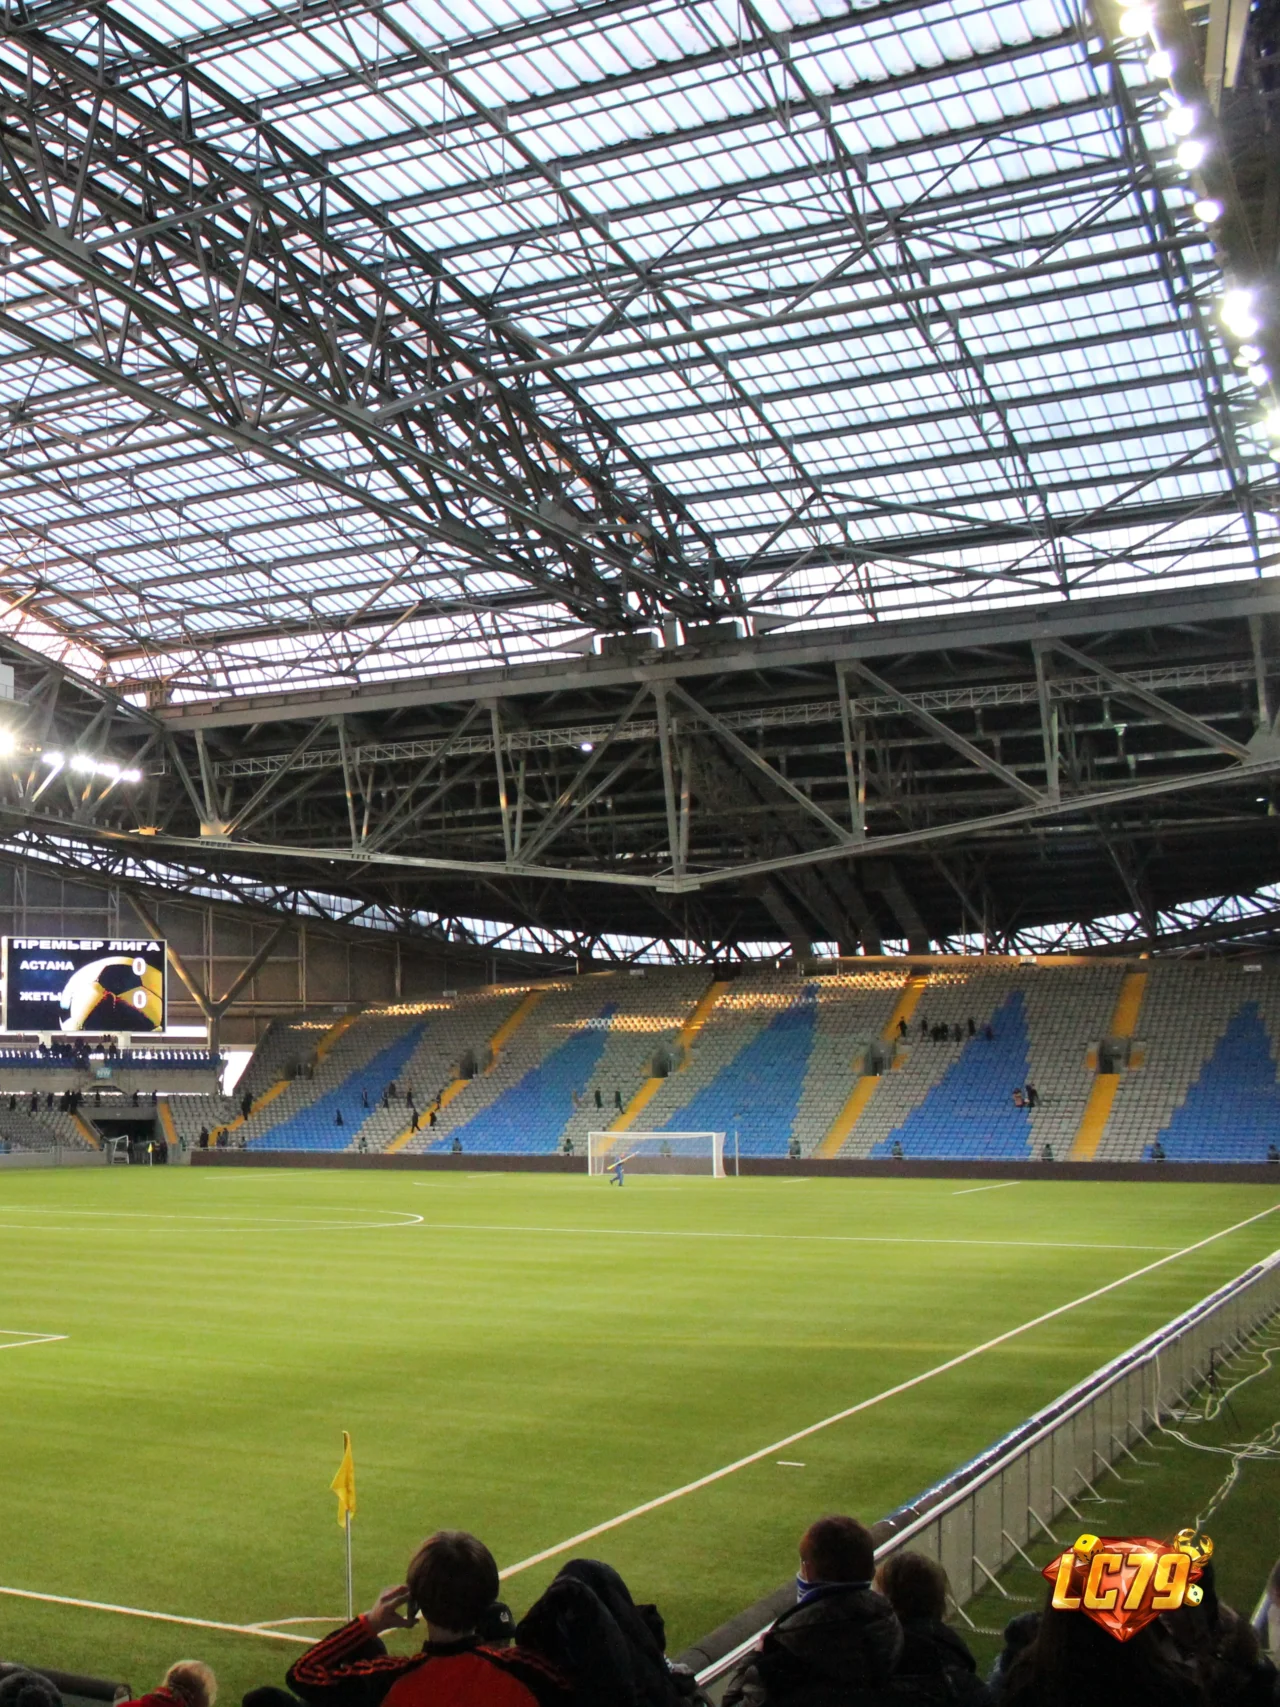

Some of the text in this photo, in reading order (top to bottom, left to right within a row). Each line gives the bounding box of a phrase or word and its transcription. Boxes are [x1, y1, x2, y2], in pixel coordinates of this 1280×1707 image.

[13, 940, 160, 951] ПРЕМЬЕР ЛИГА
[20, 960, 74, 970] АСТАНА
[132, 957, 146, 976] 0
[133, 990, 147, 1009] 0
